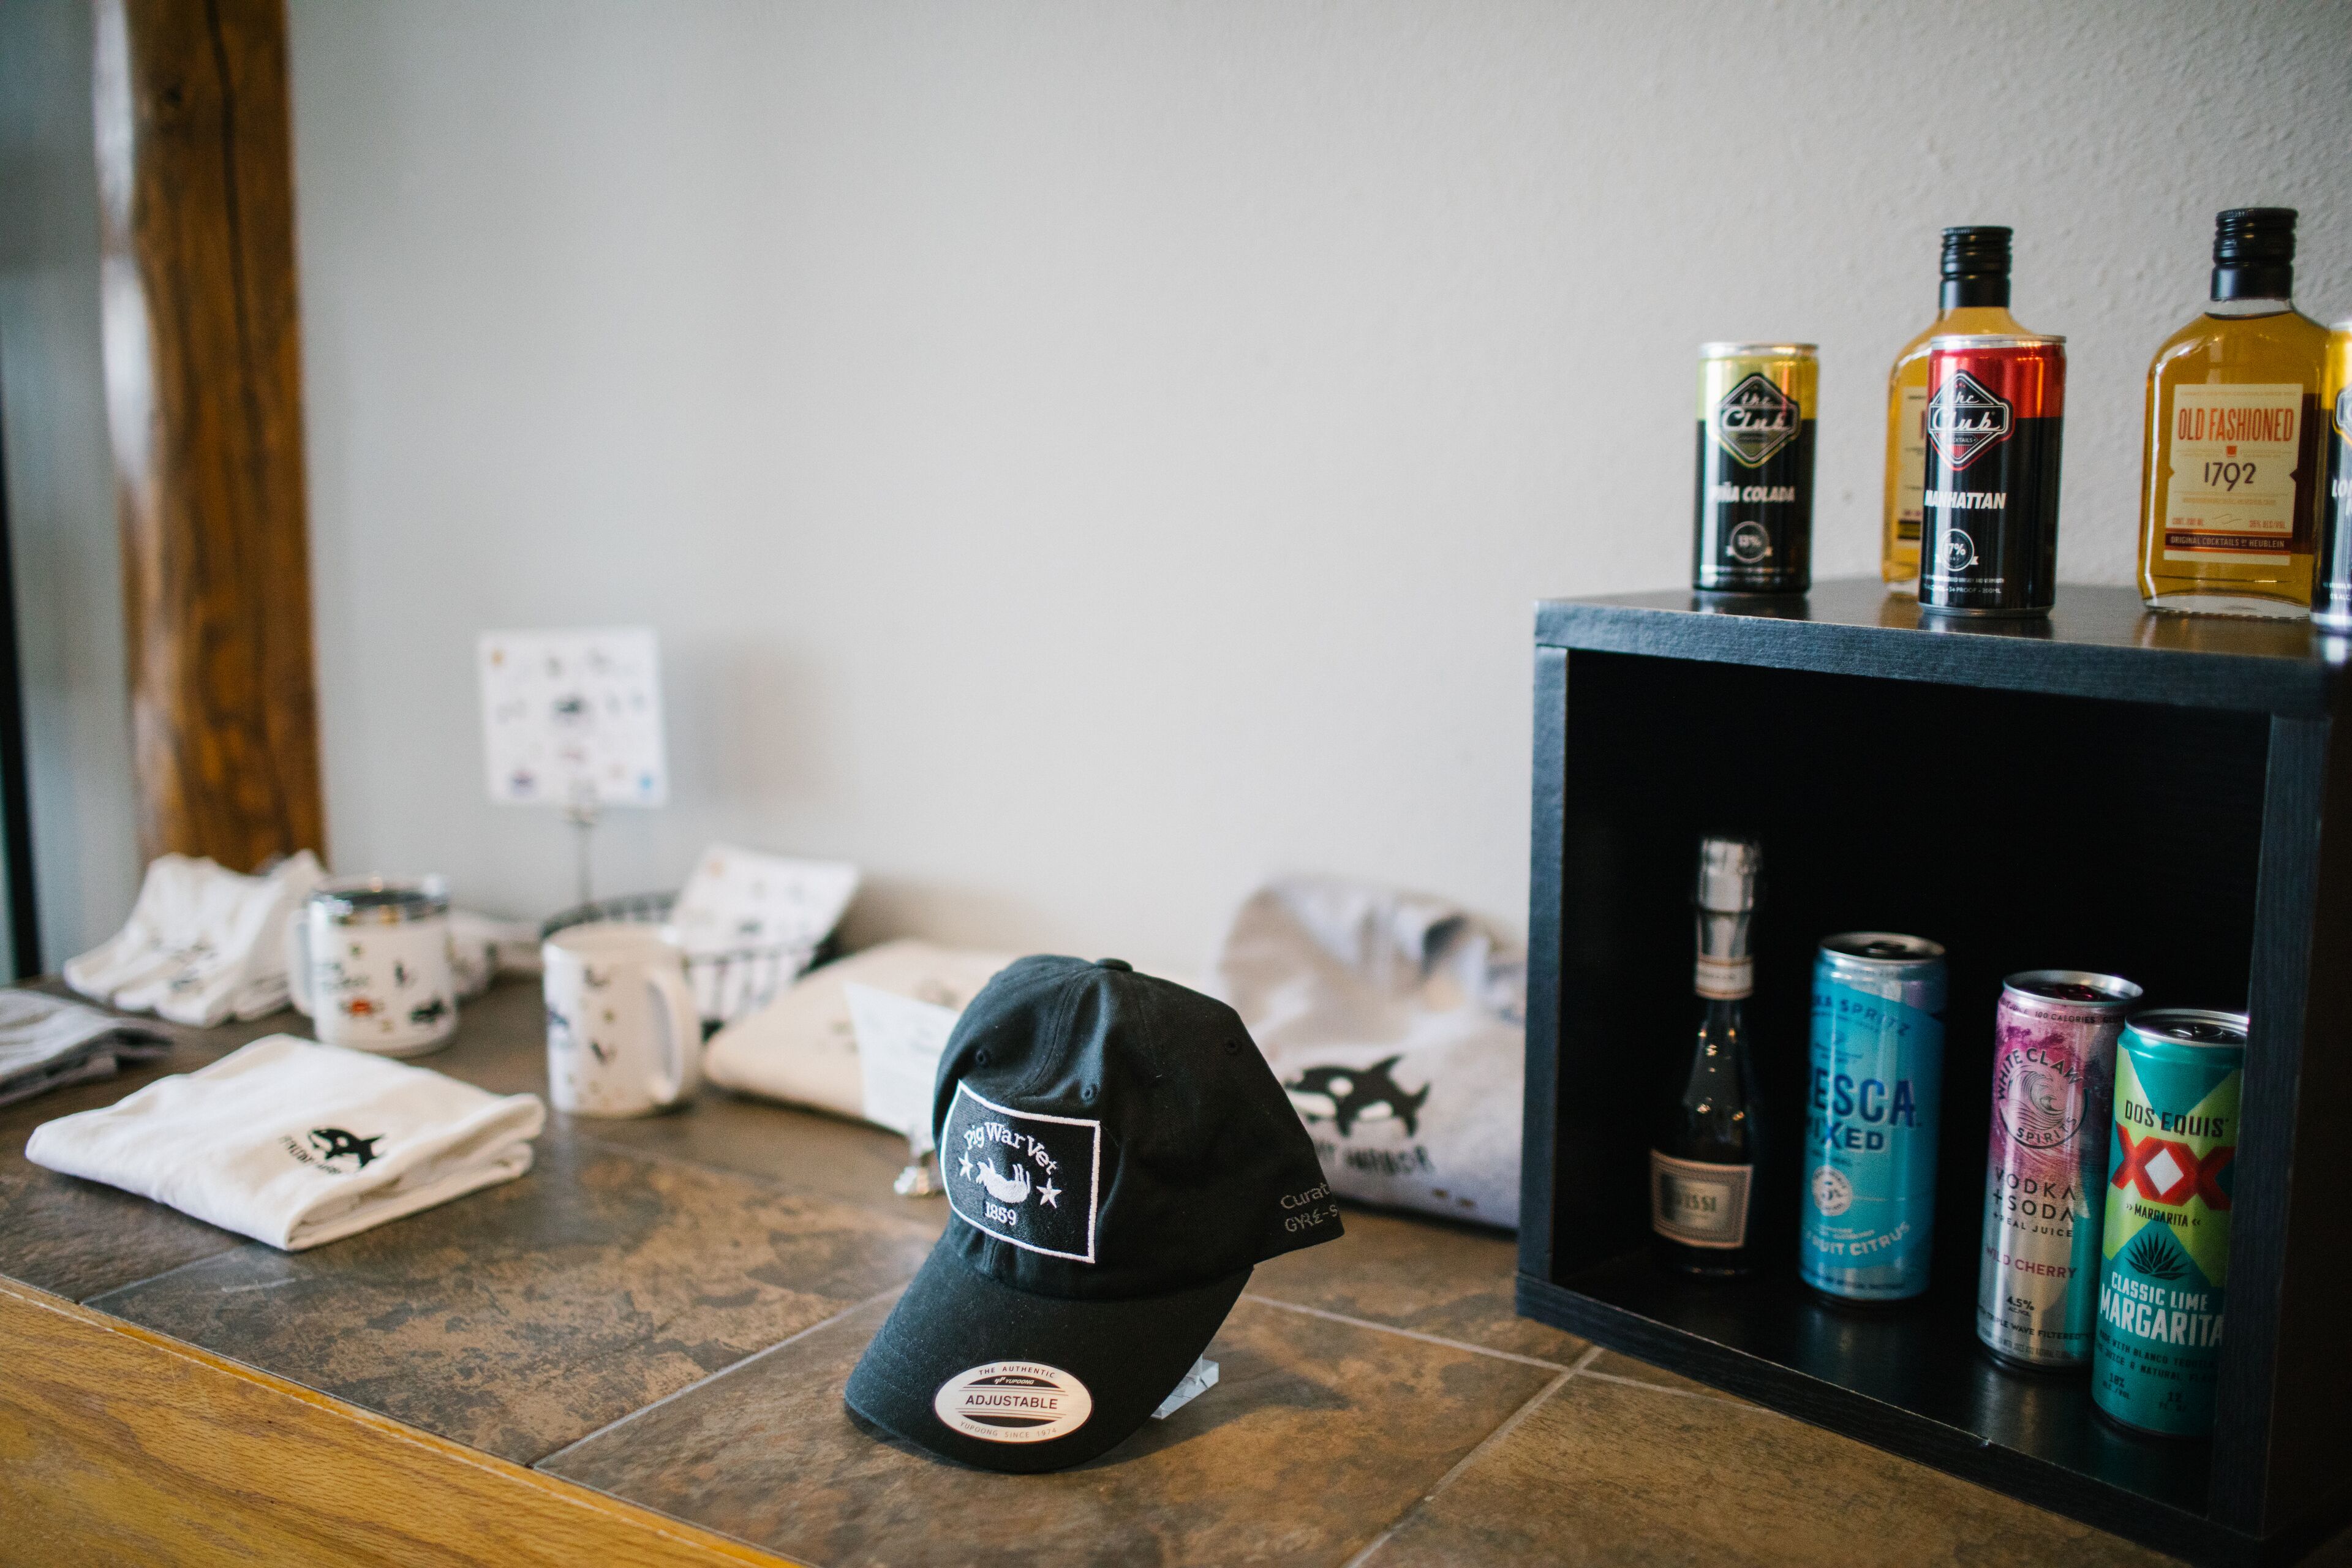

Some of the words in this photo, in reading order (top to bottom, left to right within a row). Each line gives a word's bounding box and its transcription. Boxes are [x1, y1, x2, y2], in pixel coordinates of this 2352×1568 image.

[1932, 407, 2000, 431] Club
[2178, 407, 2205, 440] OLD
[2208, 407, 2294, 442] FASHIONED
[2204, 462, 2256, 492] 1792
[1742, 485, 1795, 503] COLADA
[1924, 489, 2007, 509] MANHATTAN
[1947, 543, 1966, 556] 7%
[2171, 536, 2200, 545] ORIGINAL
[2202, 537, 2239, 546] COCKTAILS
[2249, 540, 2285, 548] HEUBLEIN
[2051, 1013, 2095, 1024] CALORIES
[1997, 1049, 2023, 1100] WHITE
[2026, 1048, 2079, 1085] CLAW
[2016, 1116, 2078, 1144] SPIRITS
[2124, 1099, 2155, 1128] DOS
[2160, 1110, 2226, 1138] EQUIS
[984, 1121, 1026, 1149] War
[1027, 1135, 1058, 1175] Vet
[1280, 1182, 1330, 1209] Curat
[1995, 1166, 2076, 1201] VODKA
[984, 1201, 1017, 1226] 1859
[2134, 1203, 2188, 1227] MARGARITA
[2032, 1224, 2073, 1238] JUICE
[2015, 1258, 2078, 1279] CHERRY
[2007, 1295, 2035, 1311] 4.5%
[2111, 1271, 2166, 1306] CLASSIC
[2171, 1291, 2209, 1311] LIME
[2100, 1282, 2225, 1348] MARGARITA
[2010, 1321, 2035, 1336] WAVE
[2113, 1339, 2131, 1354] WITH
[2133, 1348, 2169, 1365] BLANCO
[979, 1367, 996, 1376] THE
[1002, 1365, 1056, 1379] AUTHENTIC
[2140, 1365, 2183, 1381] NATURAL
[965, 1395, 1059, 1409] ADJUSTABLE
[960, 1420, 999, 1437] YUPOONG
[1036, 1427, 1057, 1436] 1974
